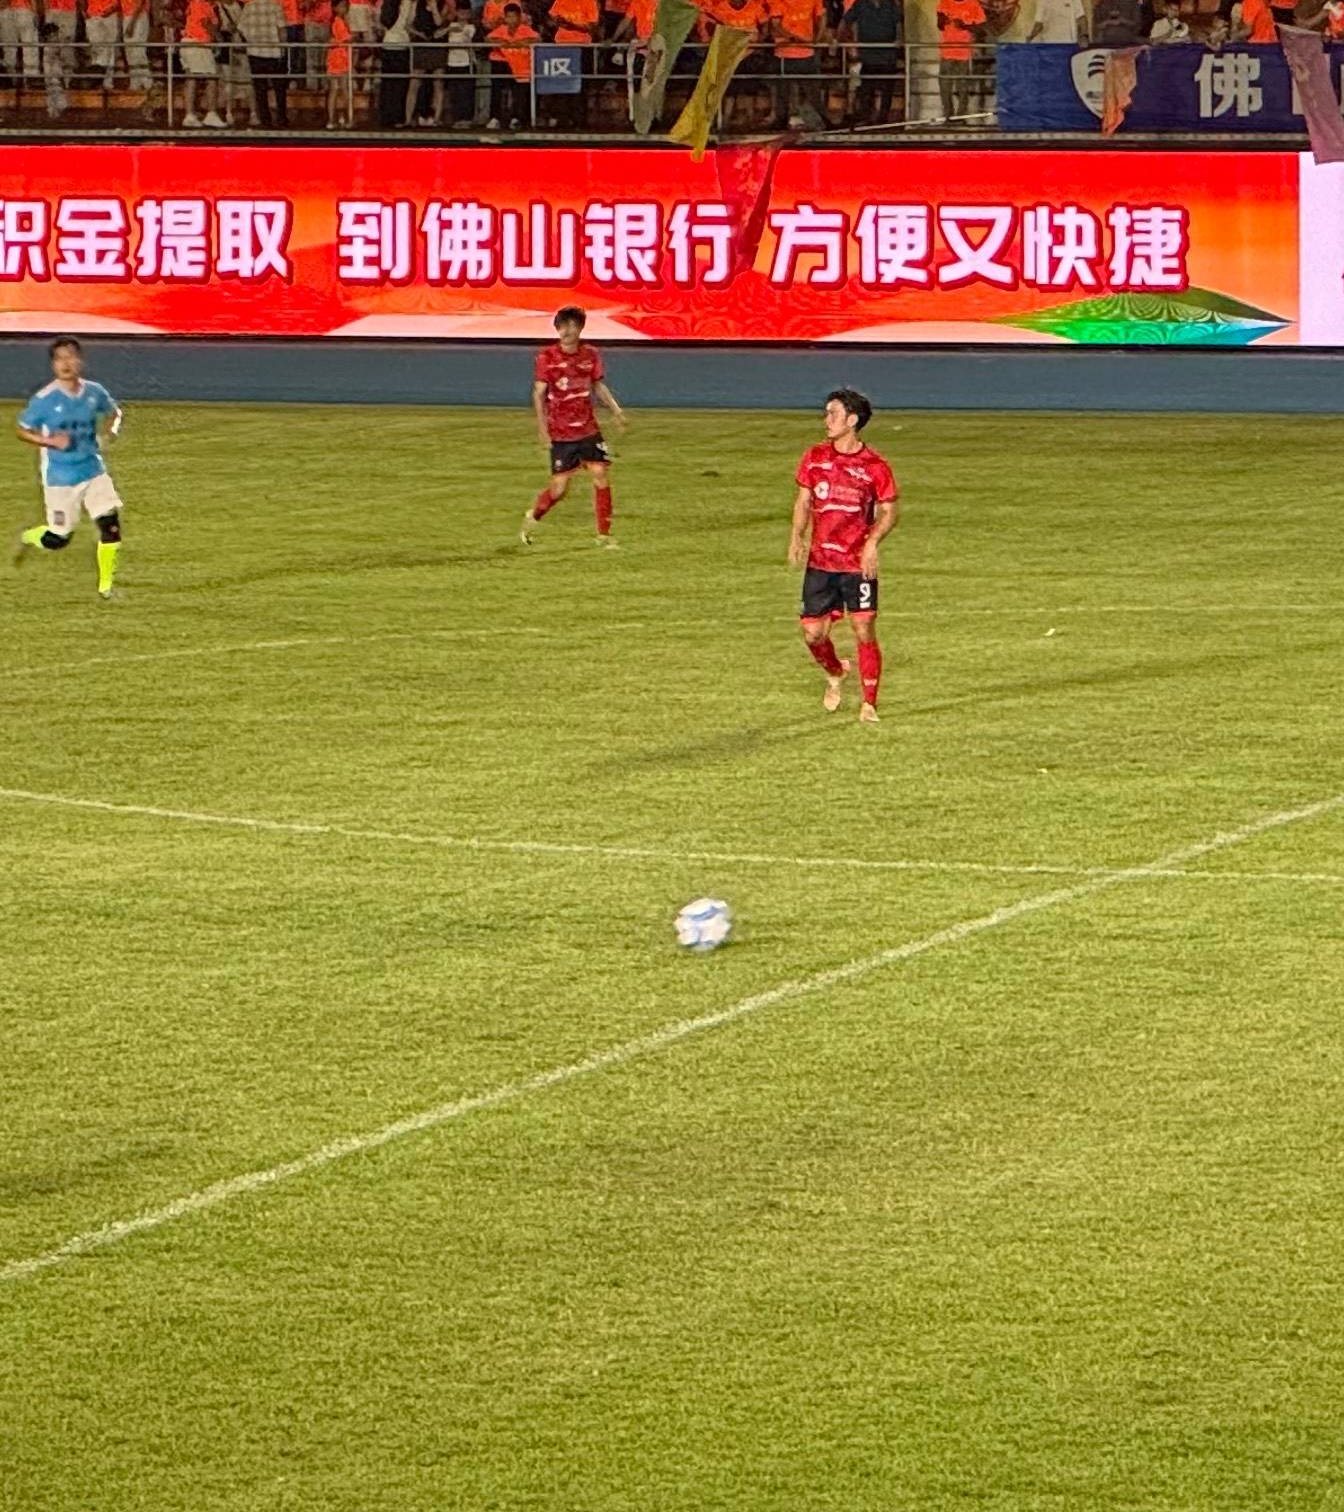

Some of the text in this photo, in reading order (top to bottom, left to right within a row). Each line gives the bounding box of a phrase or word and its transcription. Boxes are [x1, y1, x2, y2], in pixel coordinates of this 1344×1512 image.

[338, 201, 733, 283] 到佛山银行
[770, 205, 1183, 286] 方便又快捷
